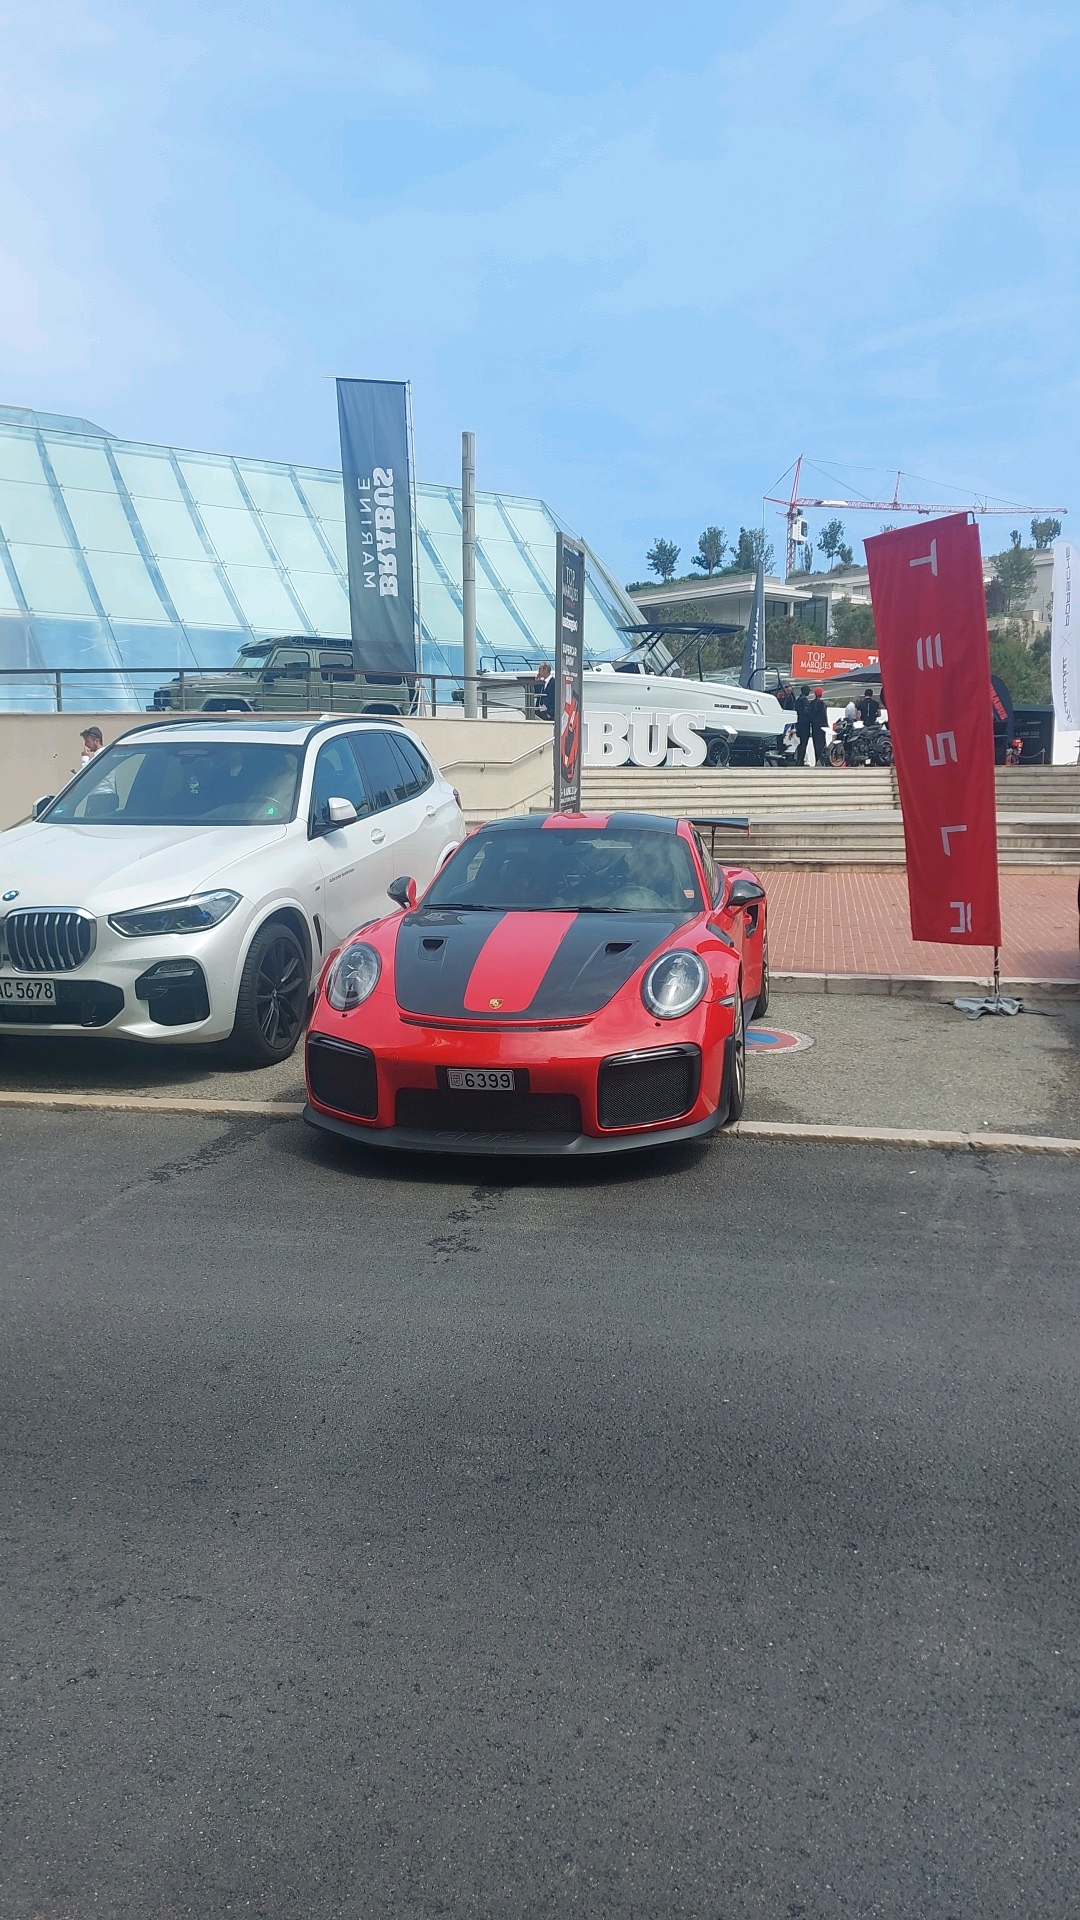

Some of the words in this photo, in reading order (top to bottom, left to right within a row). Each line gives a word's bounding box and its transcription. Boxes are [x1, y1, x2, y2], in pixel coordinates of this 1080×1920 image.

[566, 567, 575, 586] TOP
[800, 661, 831, 669] MARQUES
[807, 651, 826, 662] TOP
[583, 711, 708, 767] BUS
[909, 538, 973, 933] TESLA
[16, 982, 53, 999] 5678
[464, 1073, 511, 1088] 6399
